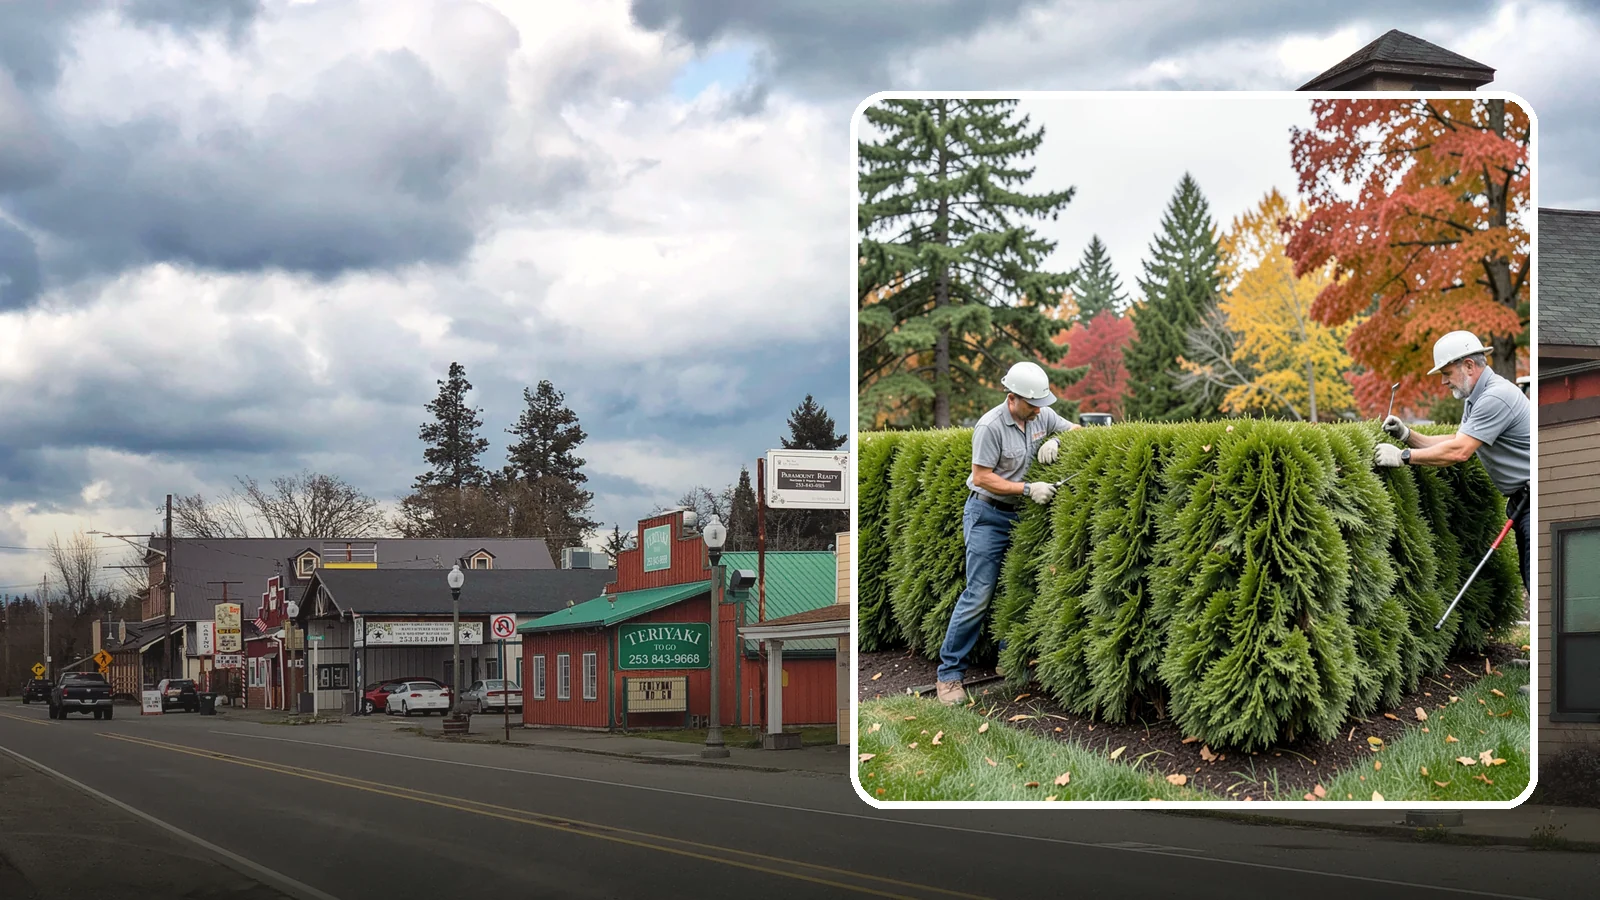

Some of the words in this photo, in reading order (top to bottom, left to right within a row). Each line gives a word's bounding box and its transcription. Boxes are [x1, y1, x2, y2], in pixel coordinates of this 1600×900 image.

[624, 627, 702, 646] TERIYAKI
[629, 654, 649, 664] 253
[651, 653, 700, 664] 843-9668
[639, 681, 672, 691] TERIYAKI
